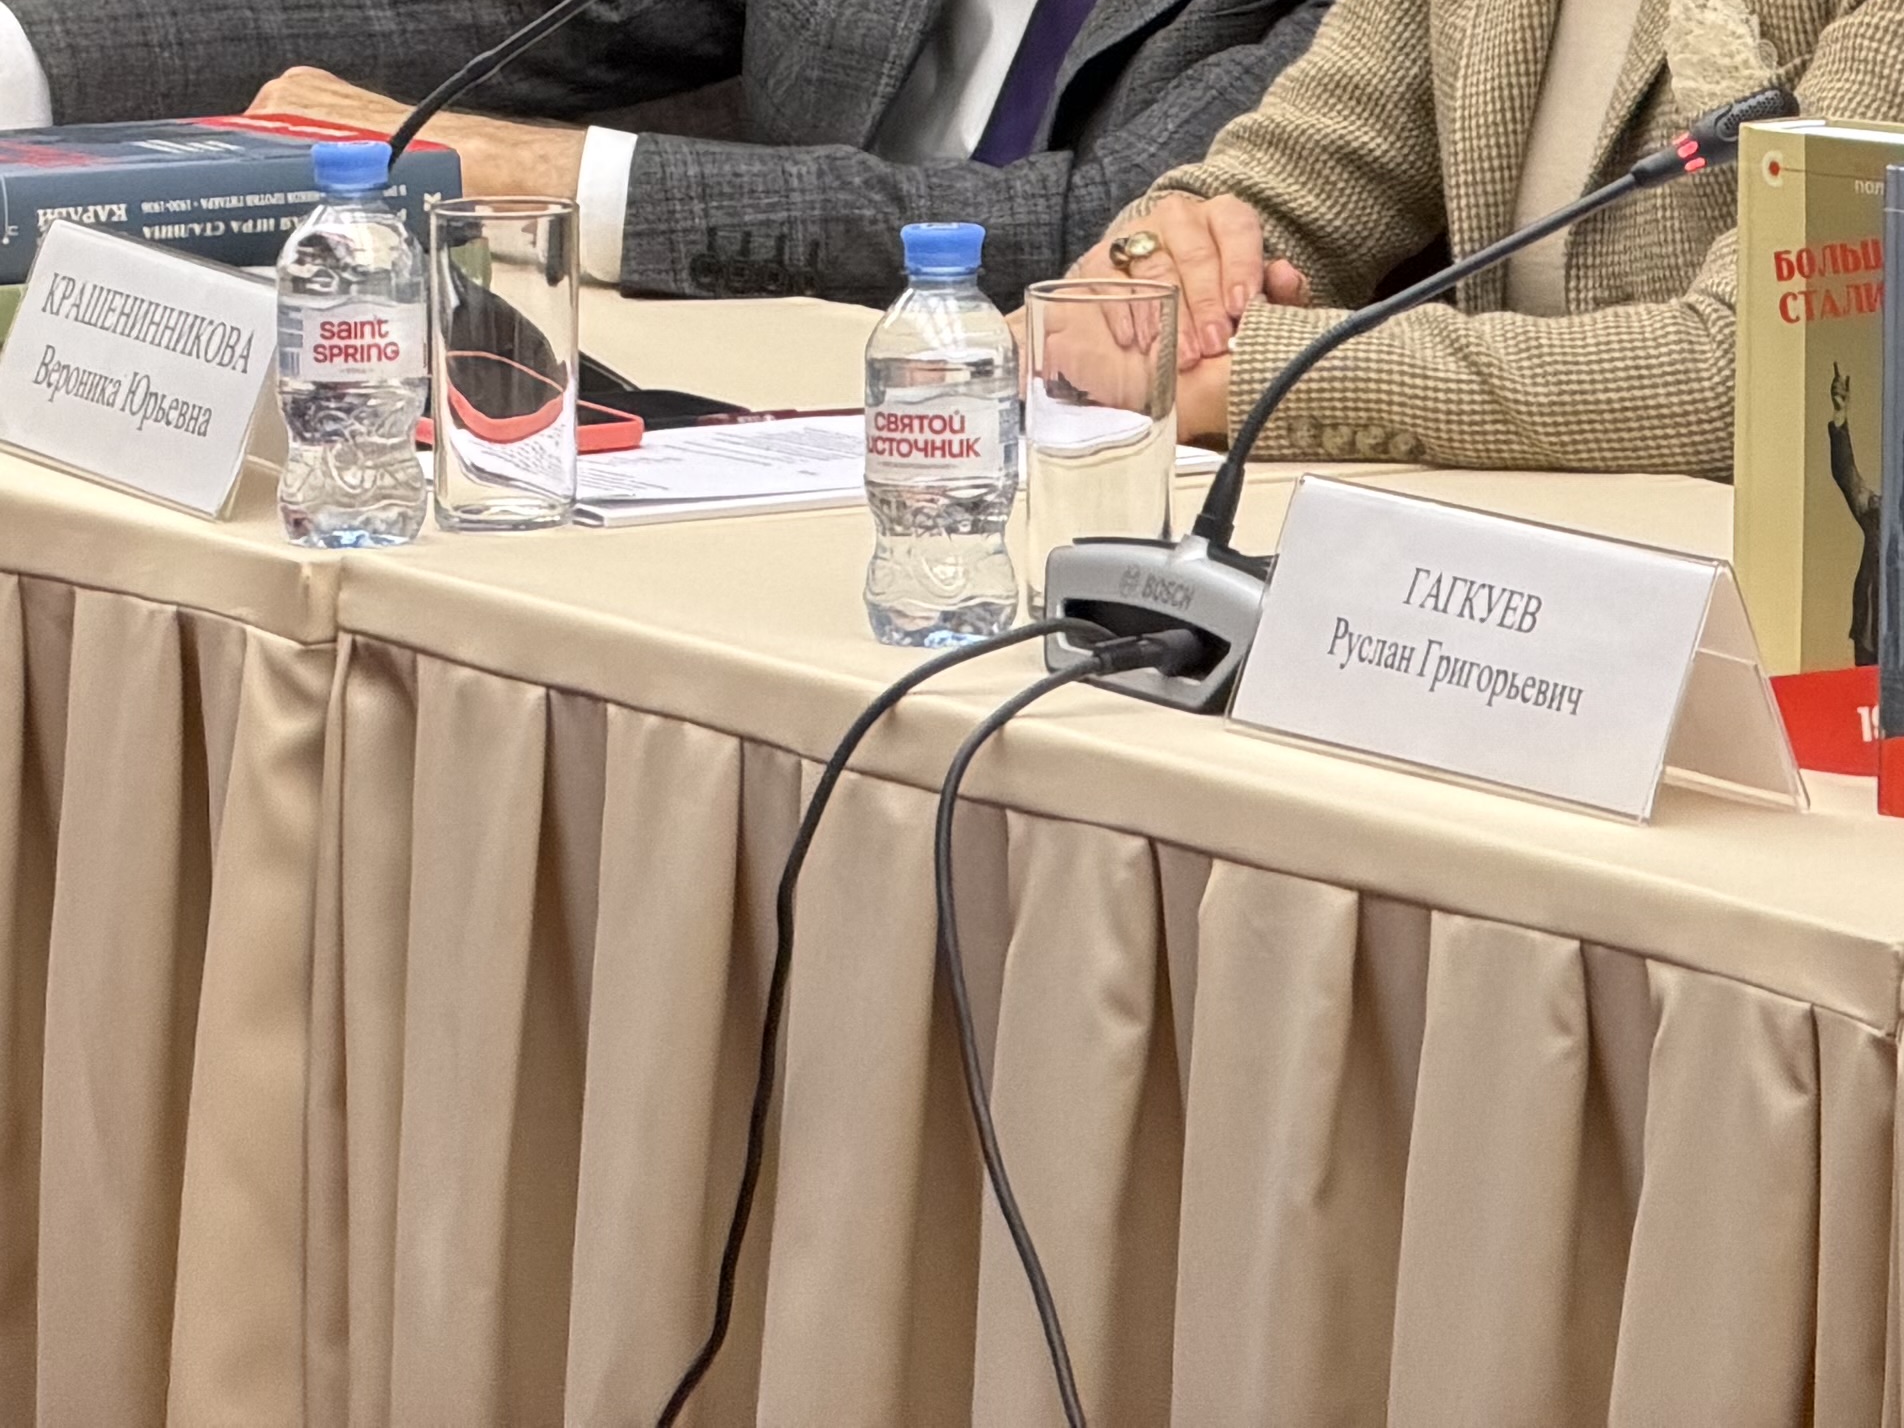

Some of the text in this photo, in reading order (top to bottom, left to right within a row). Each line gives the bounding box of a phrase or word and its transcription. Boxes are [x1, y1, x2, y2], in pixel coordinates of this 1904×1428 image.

[1774, 238, 1884, 282] БОЛЬШ
[41, 272, 255, 375] КРАШЕНИННИКОВА
[1779, 282, 1884, 324] СТАЛИ
[319, 317, 389, 341] saint
[33, 344, 213, 438] Вероника Юрьевна
[874, 409, 966, 435] СВЯТОЙ
[866, 433, 982, 459] ИСТОЧНИК
[1401, 567, 1543, 635] ГАГКУЕВ
[1327, 616, 1584, 717] Руслан Григорьевич
